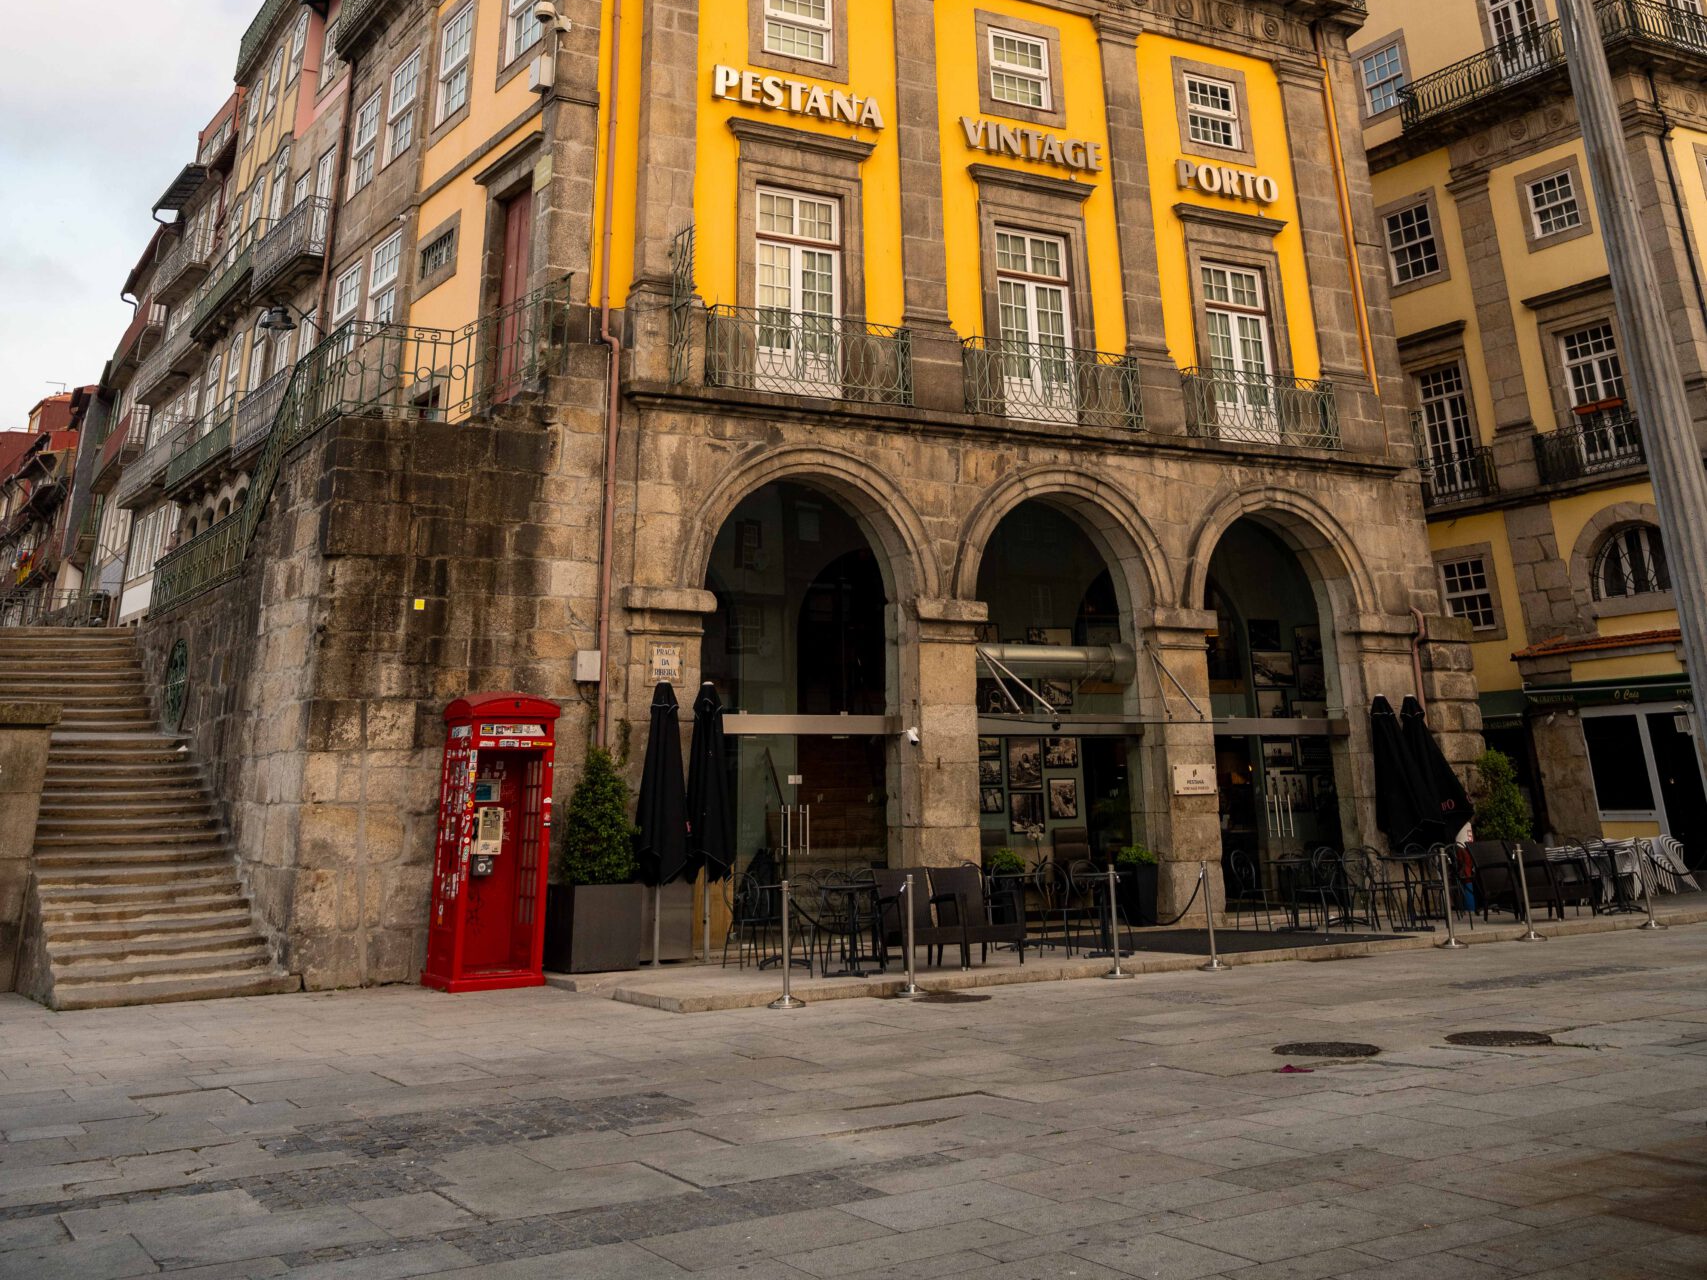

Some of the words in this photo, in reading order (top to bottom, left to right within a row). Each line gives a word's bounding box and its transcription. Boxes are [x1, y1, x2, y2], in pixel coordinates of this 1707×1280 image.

[712, 64, 885, 130] PESTANA
[959, 116, 1103, 172] VINTAGE
[1175, 159, 1279, 203] PORTO
[661, 658, 670, 666] DA
